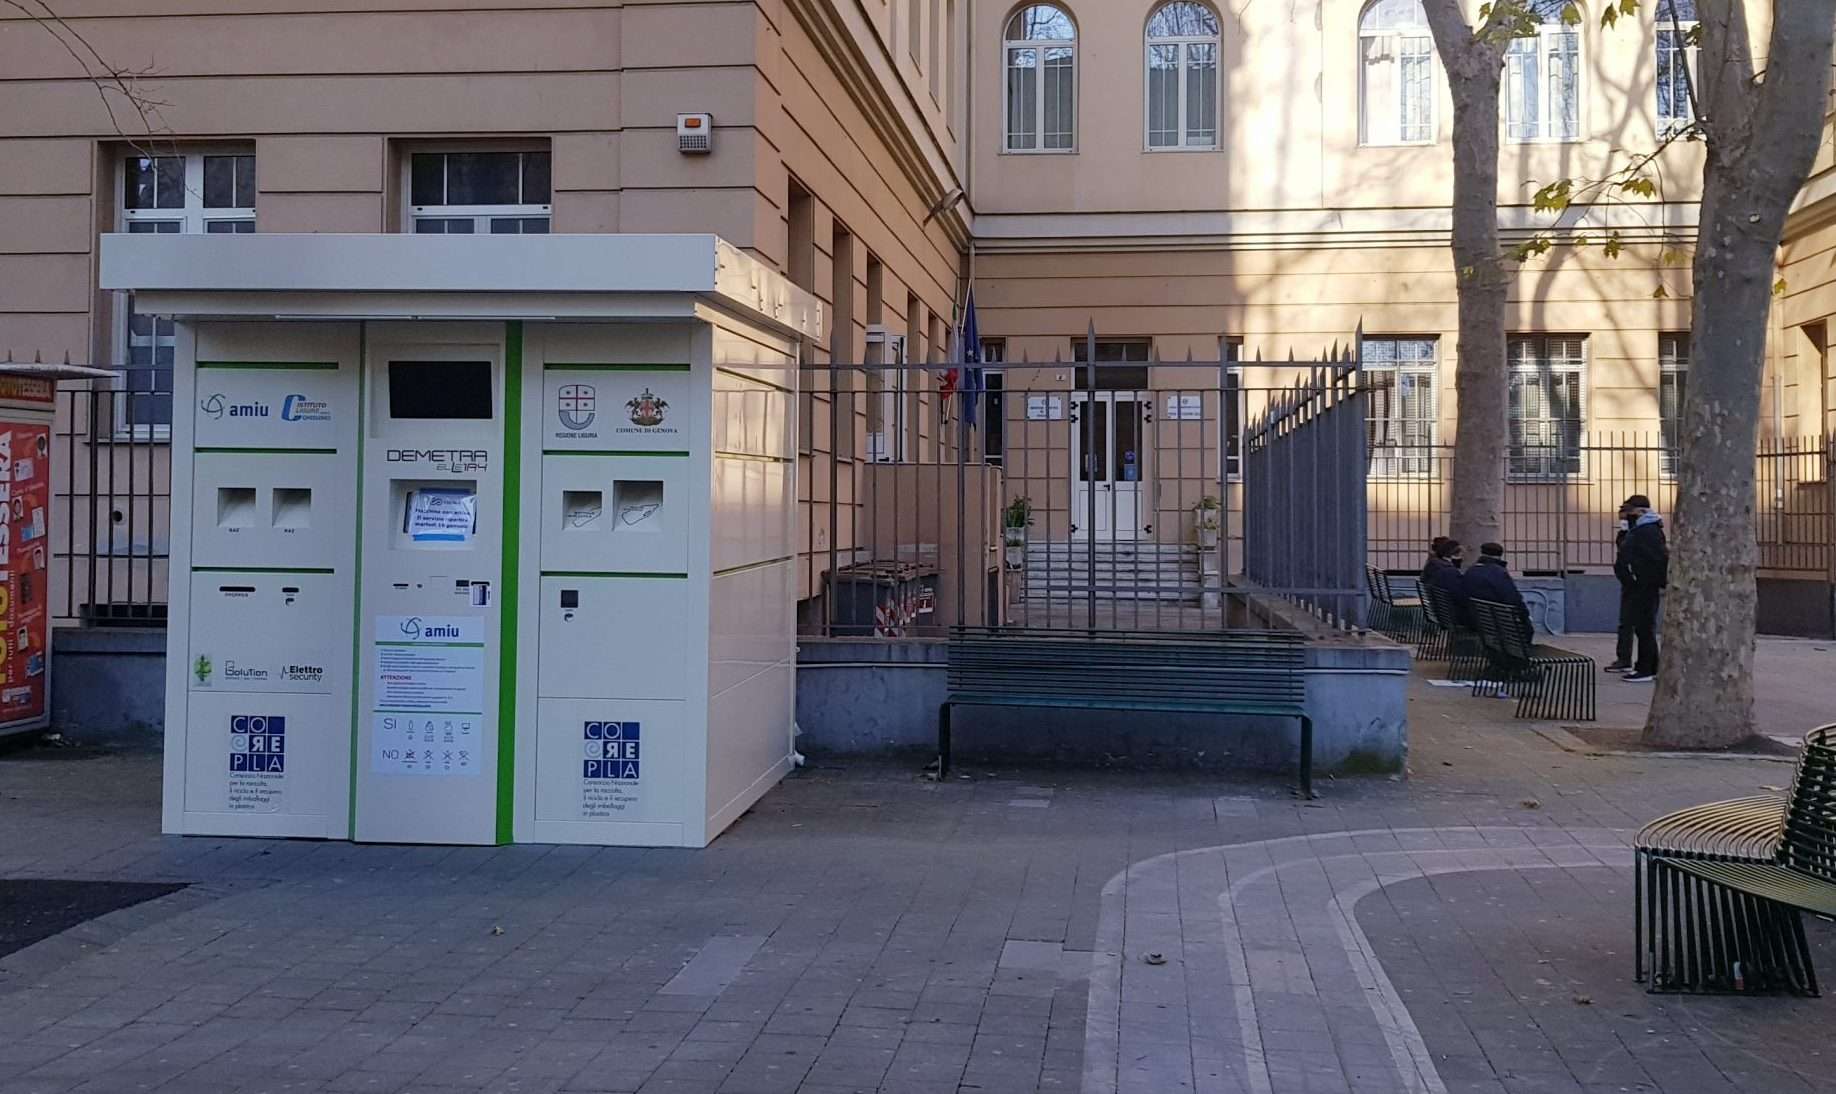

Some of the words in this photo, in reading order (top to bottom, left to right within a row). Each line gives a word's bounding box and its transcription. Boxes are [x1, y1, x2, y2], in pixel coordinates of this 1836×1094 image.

[230, 402, 269, 417] amiu
[386, 450, 487, 462] DEMETRA
[425, 624, 460, 637] amiu
[289, 666, 323, 674] Elettro
[289, 673, 322, 682] security
[384, 718, 396, 730] SI
[382, 750, 399, 760] NO
[234, 755, 282, 771] PLA
[588, 761, 637, 777] PLA
